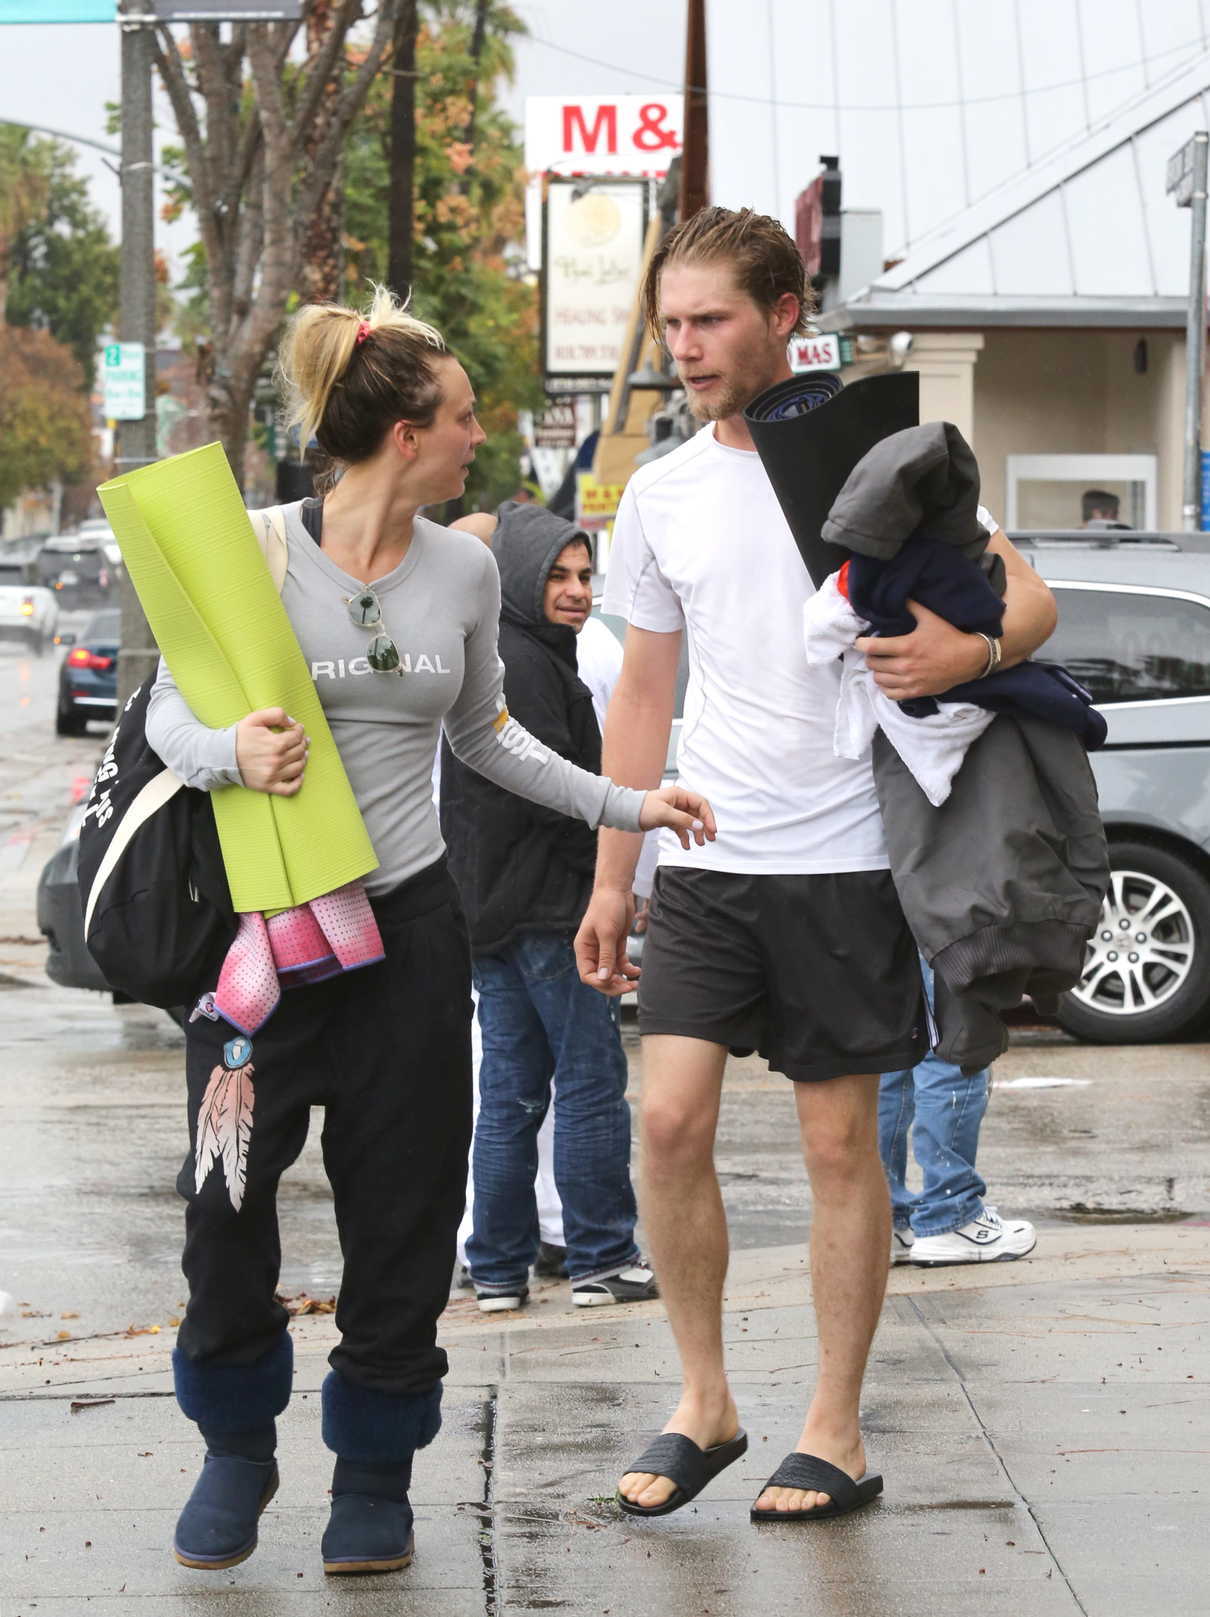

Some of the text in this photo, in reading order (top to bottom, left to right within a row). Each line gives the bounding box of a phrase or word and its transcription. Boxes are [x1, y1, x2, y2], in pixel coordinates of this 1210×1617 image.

[562, 103, 682, 154] M &
[311, 653, 450, 680] RIGNAL
